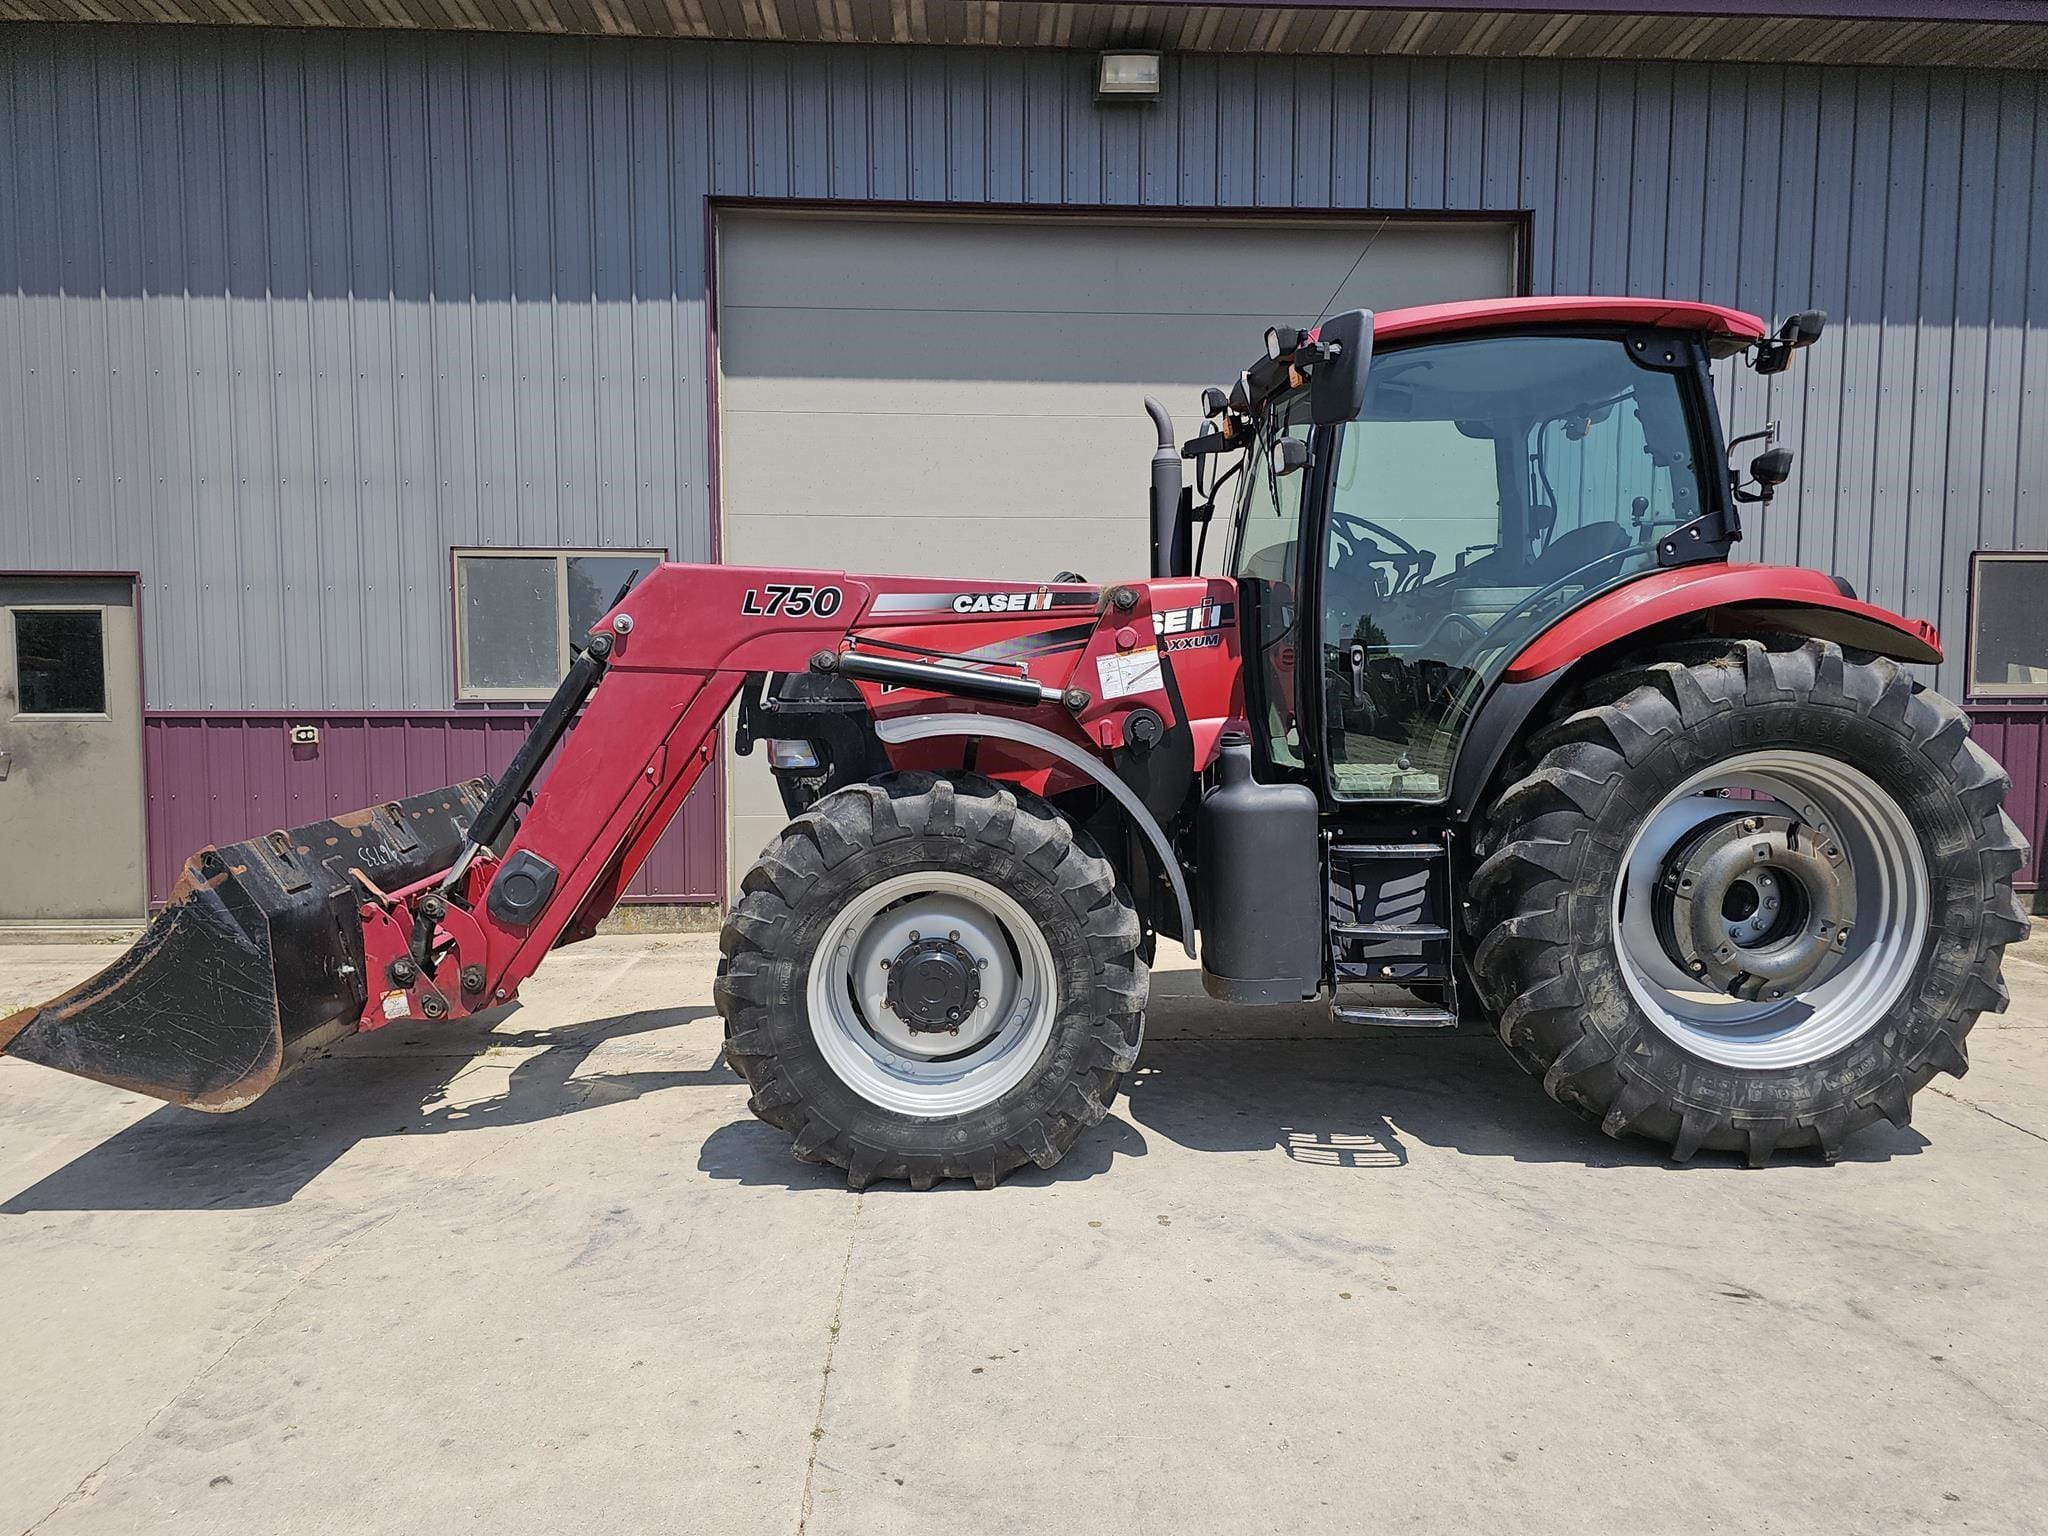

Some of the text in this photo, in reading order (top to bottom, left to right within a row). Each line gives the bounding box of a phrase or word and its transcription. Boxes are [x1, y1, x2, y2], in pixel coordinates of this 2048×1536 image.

[741, 584, 843, 618] L750
[1151, 609, 1188, 635] SE
[1167, 634, 1220, 651] XXUM
